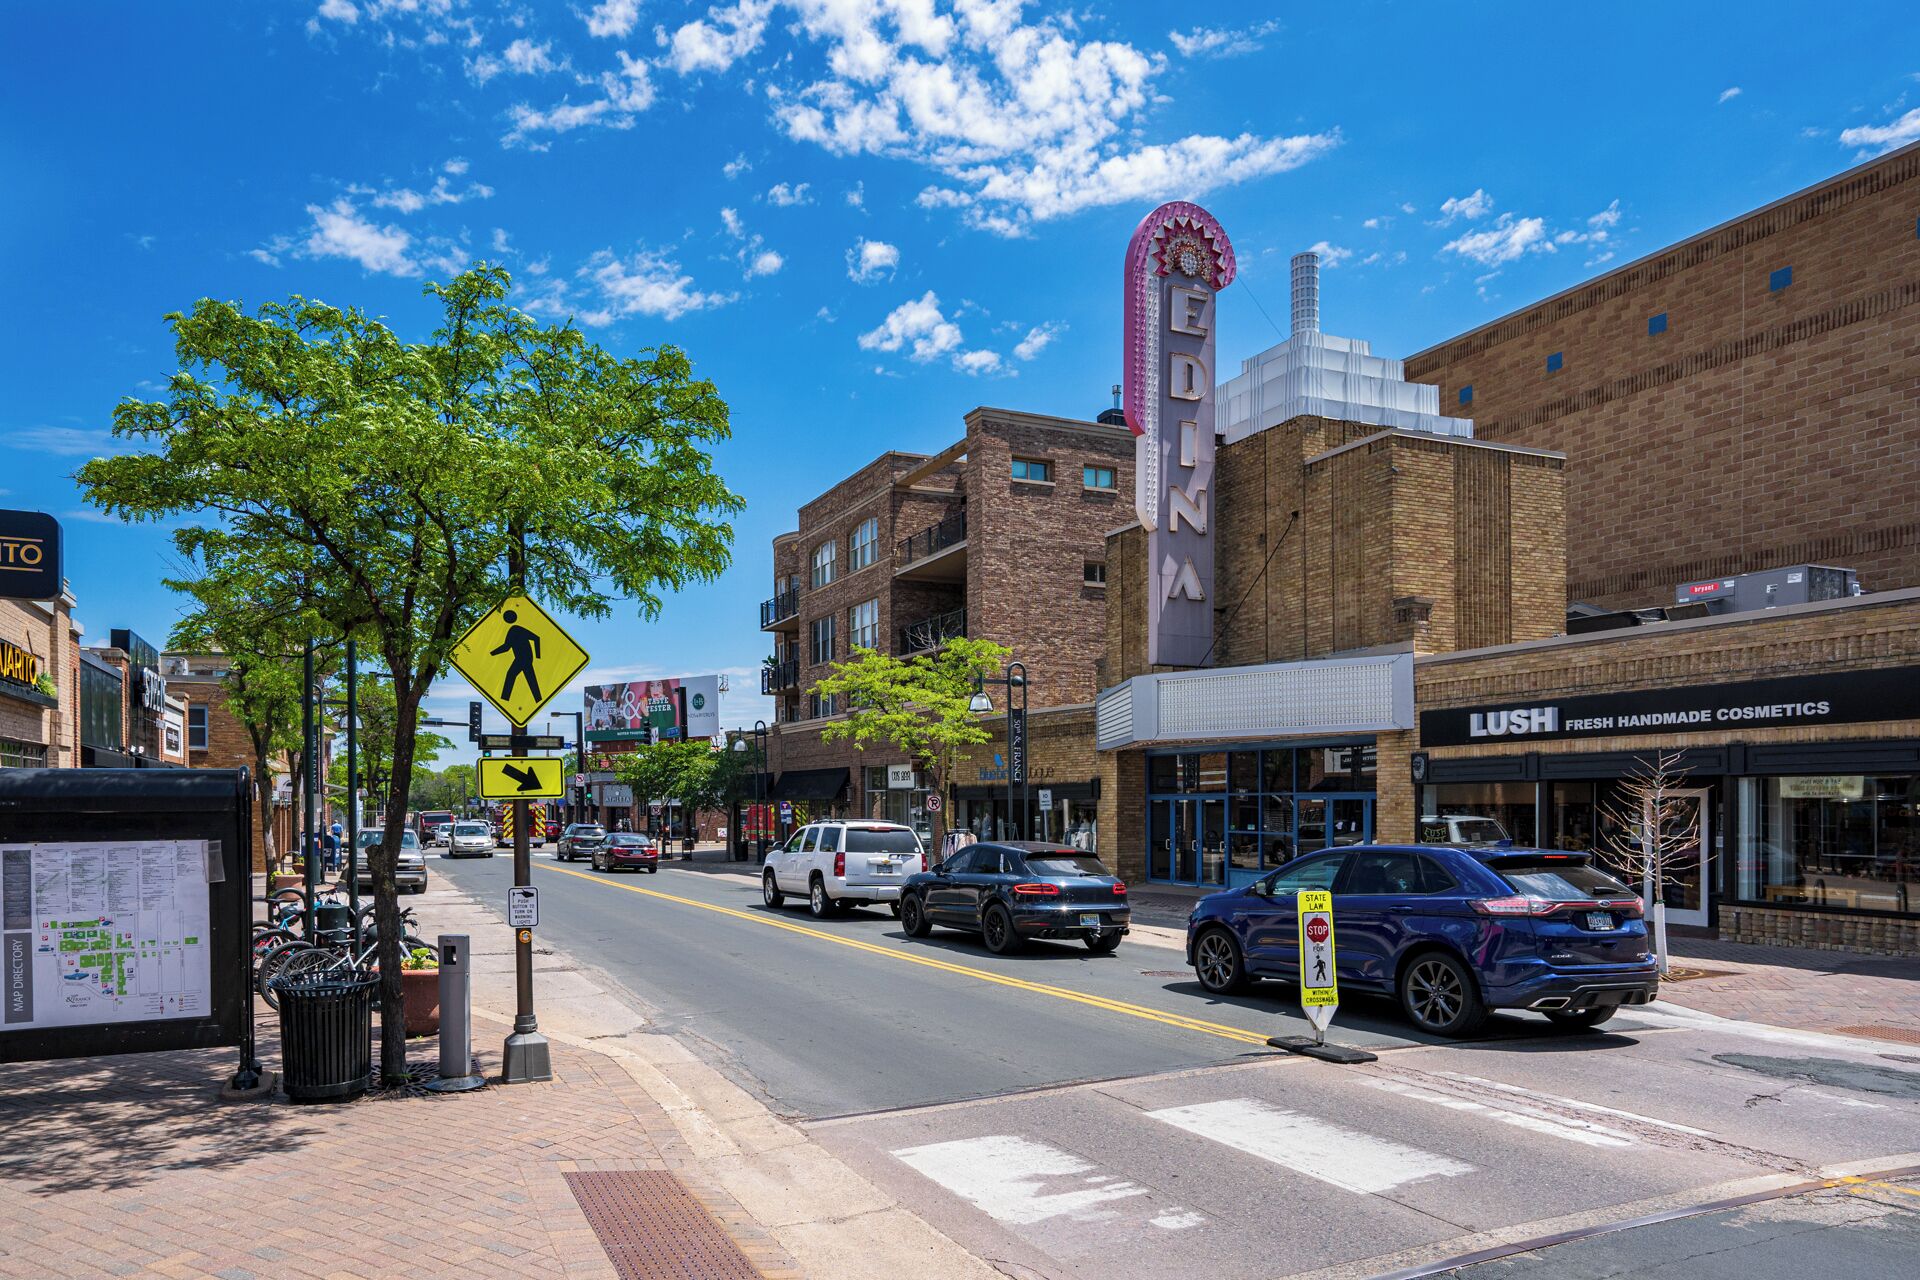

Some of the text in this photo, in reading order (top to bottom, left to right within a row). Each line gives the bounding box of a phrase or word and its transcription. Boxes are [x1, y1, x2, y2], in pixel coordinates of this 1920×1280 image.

[1169, 283, 1208, 600] EDINA
[1694, 584, 1714, 593] bryant
[648, 697, 669, 705] TASTE
[646, 704, 672, 713] TESTER
[1469, 706, 1558, 737] LUSH
[1565, 701, 1830, 731] FRESH HANDMADE COSMETICS
[1013, 736, 1021, 746] &
[1013, 747, 1022, 783] FRANCE
[1306, 894, 1326, 902] STATE
[1308, 925, 1327, 936] STOP
[12, 939, 24, 1012] MAP DIRECTORY
